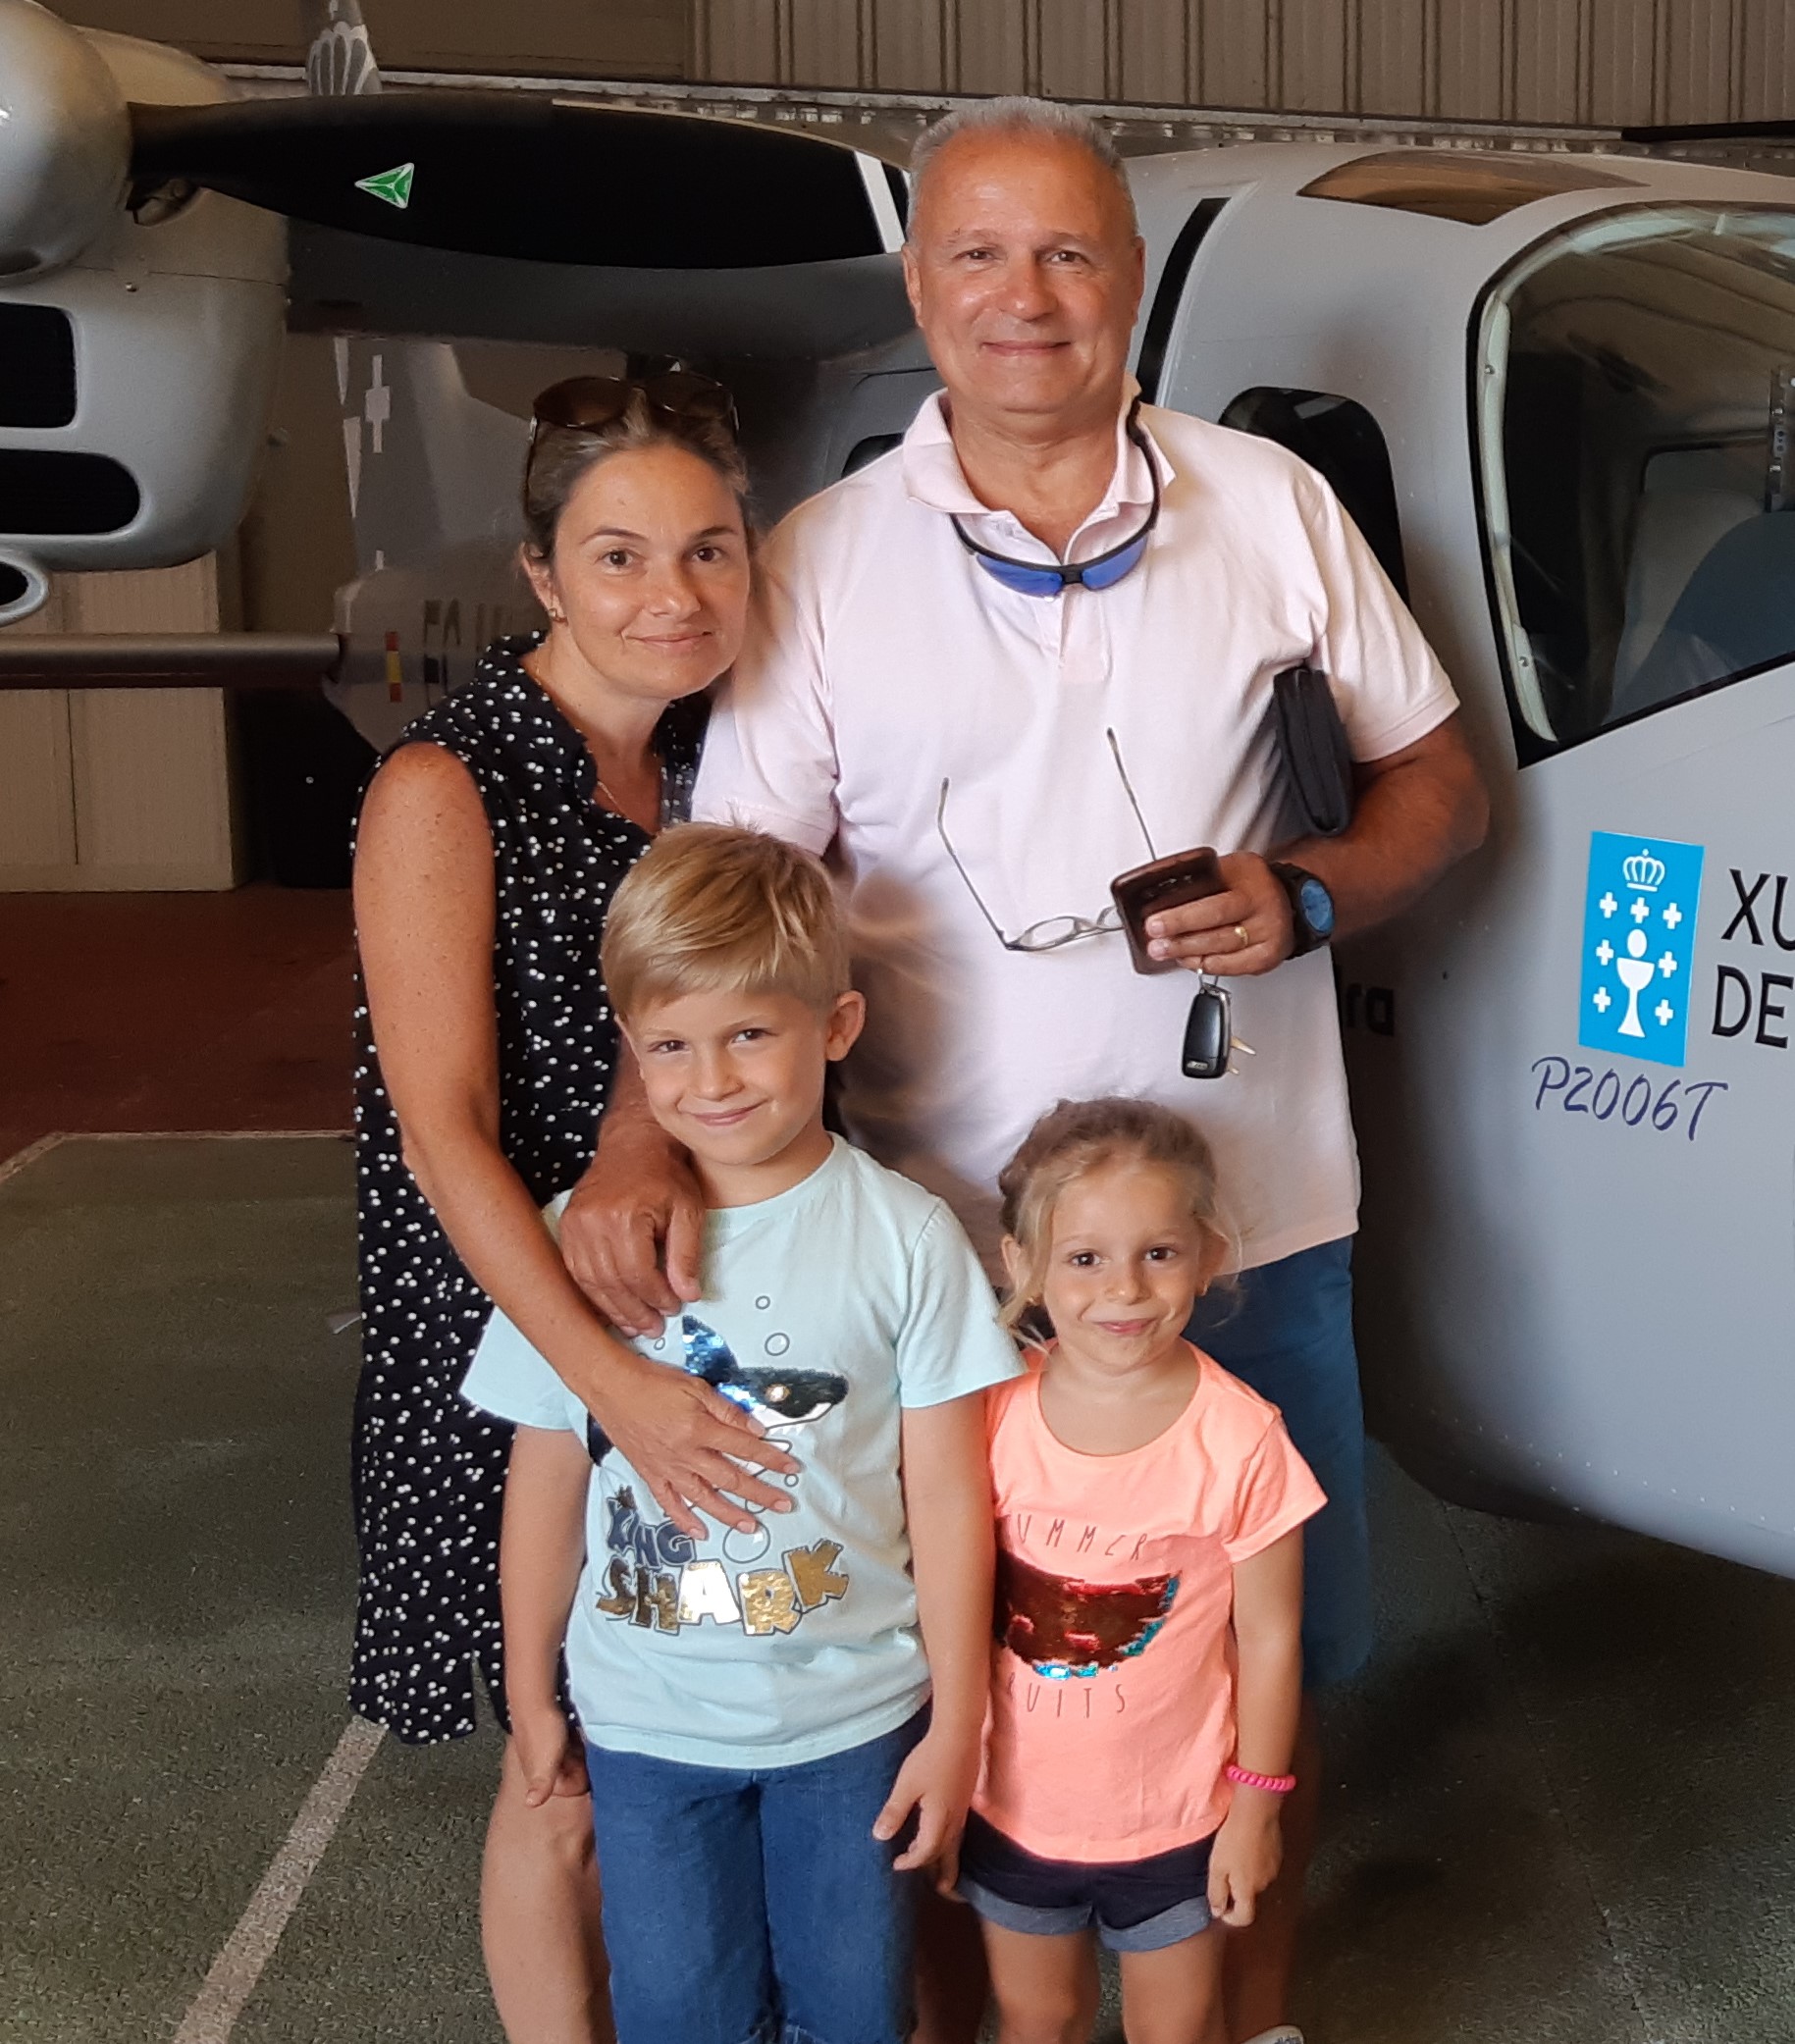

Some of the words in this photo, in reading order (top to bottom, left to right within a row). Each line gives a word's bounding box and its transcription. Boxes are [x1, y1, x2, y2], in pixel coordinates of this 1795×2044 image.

[1712, 965, 1794, 1049] DE
[1531, 1056, 1728, 1141] P2006T
[595, 1538, 850, 1637] SHARK
